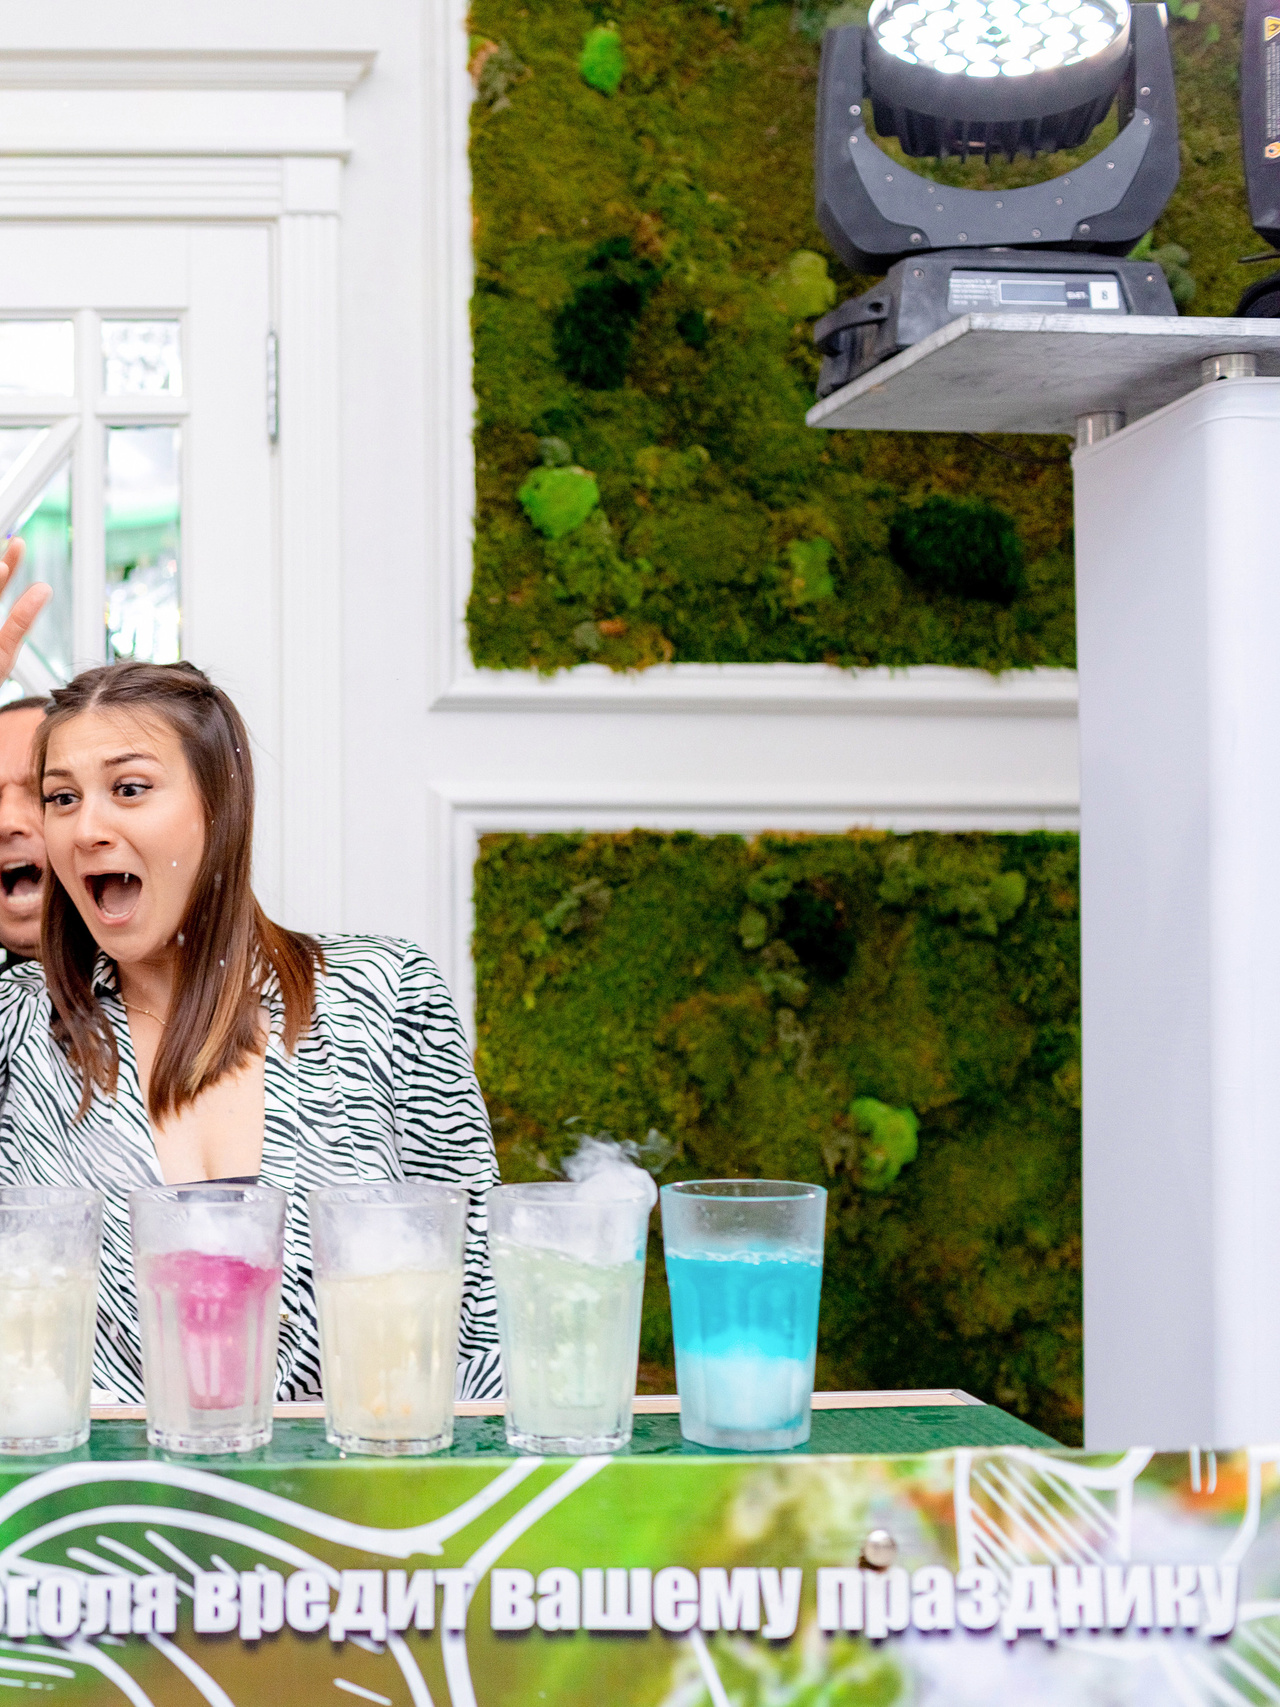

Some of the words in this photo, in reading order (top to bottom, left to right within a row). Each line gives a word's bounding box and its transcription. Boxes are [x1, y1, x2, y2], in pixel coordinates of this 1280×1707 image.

[193, 1567, 474, 1642] вредит
[490, 1566, 803, 1640] вашему
[816, 1563, 1241, 1641] празднику
